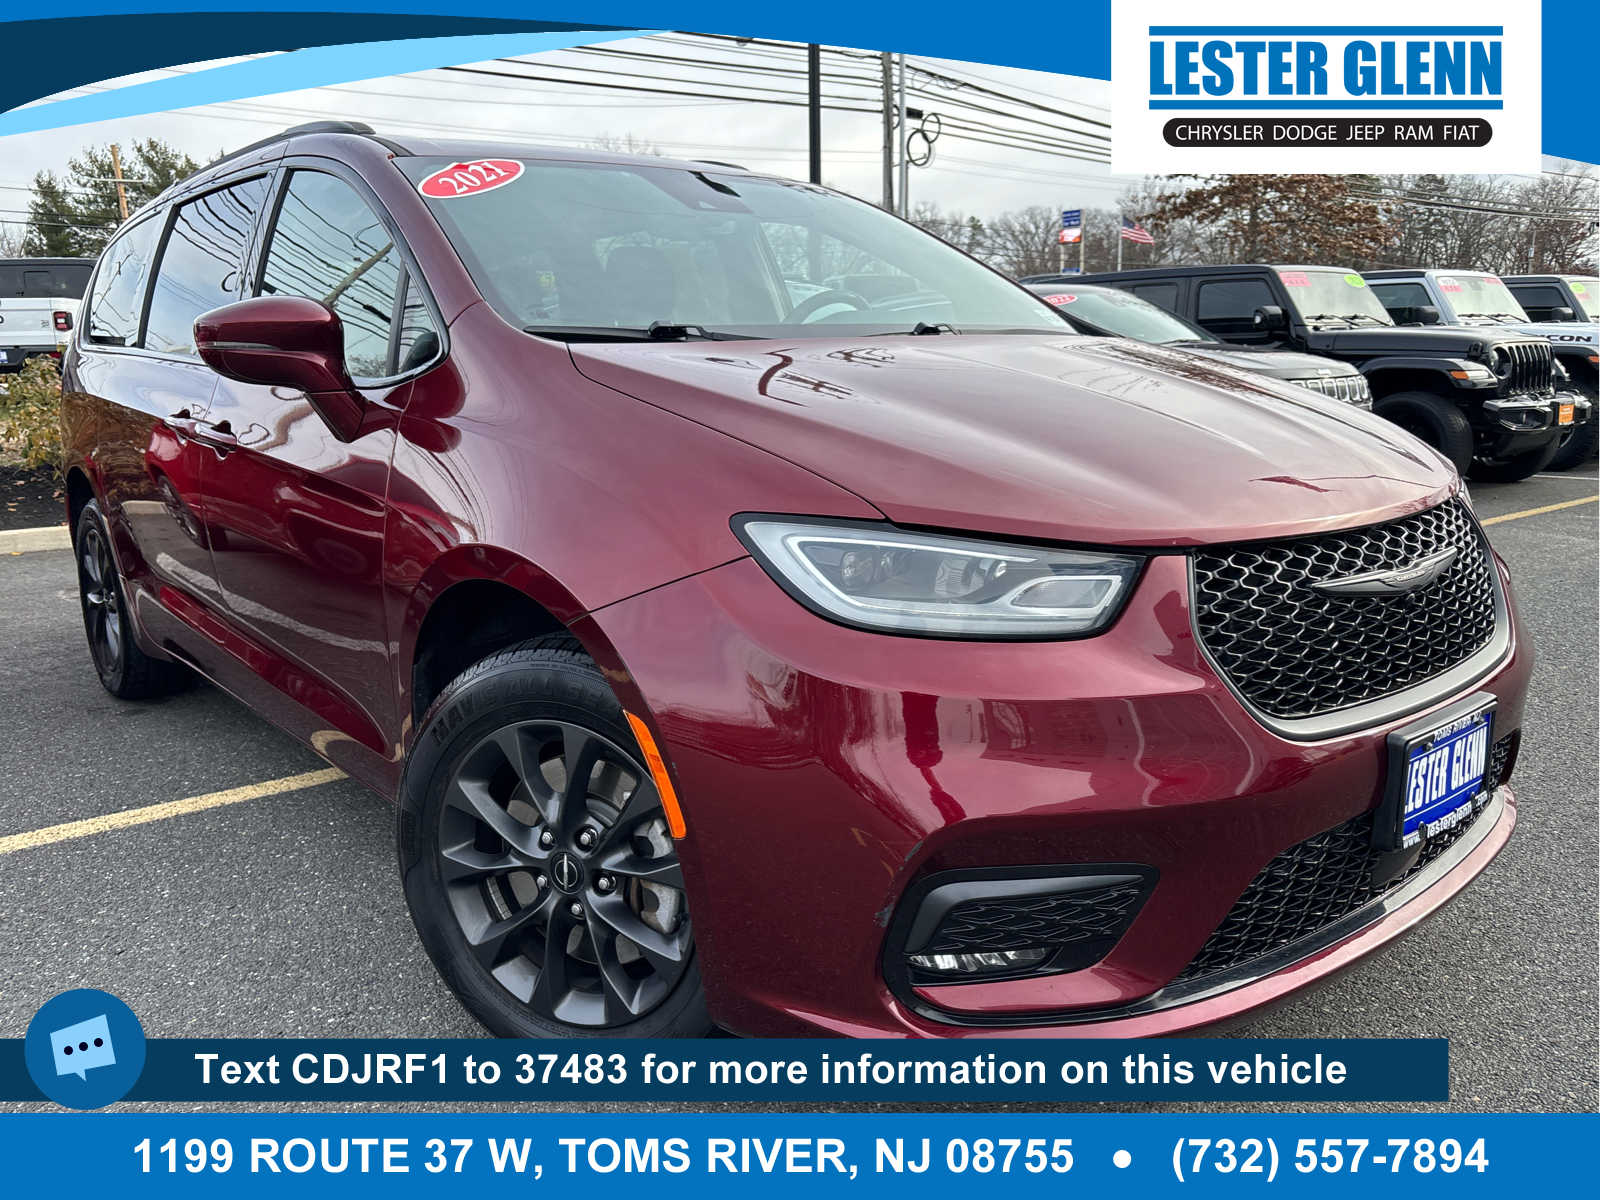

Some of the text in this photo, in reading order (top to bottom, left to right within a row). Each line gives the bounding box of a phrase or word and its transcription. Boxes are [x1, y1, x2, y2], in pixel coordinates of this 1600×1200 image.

[438, 161, 509, 194] 2021
[1404, 726, 1488, 815] LESTER GLENN
